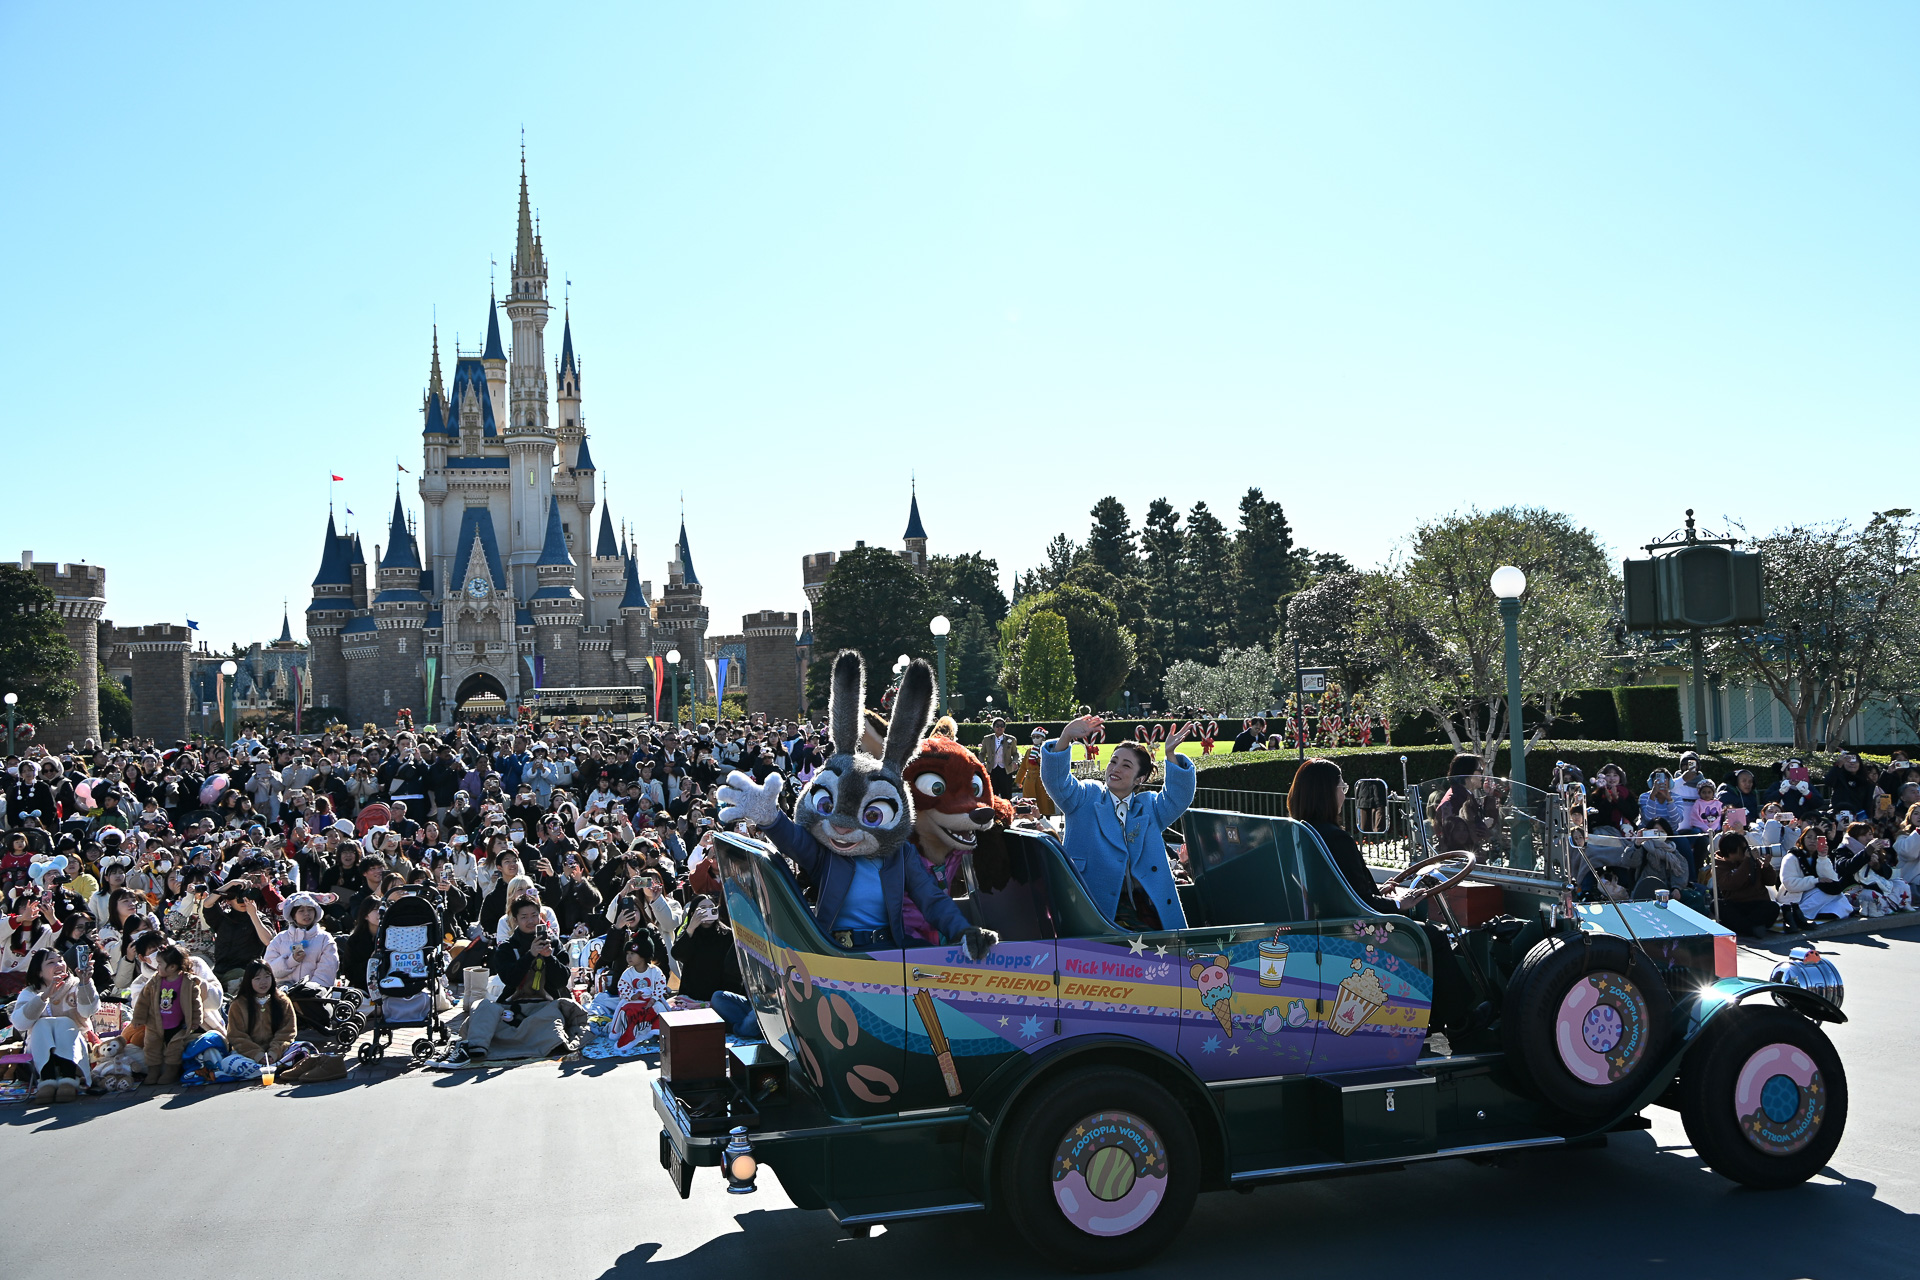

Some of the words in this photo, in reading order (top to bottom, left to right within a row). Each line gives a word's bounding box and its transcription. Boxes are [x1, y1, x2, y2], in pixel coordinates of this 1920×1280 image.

[395, 953, 420, 961] GOOD
[986, 952, 1032, 969] Hopps
[1065, 958, 1099, 975] Nick
[1102, 962, 1143, 979] Wilde
[937, 971, 983, 986] BEST
[985, 975, 1052, 992] FRIEND
[1064, 982, 1134, 999] ENERGY
[1609, 986, 1638, 1022] ZOOTOPIA
[1624, 1023, 1639, 1057] WORLD
[1791, 1098, 1815, 1138] ZOOTOPIA
[1072, 1125, 1117, 1157] ZOOTOPIA
[1119, 1126, 1148, 1154] WORLD
[1762, 1128, 1791, 1142] WORLD
